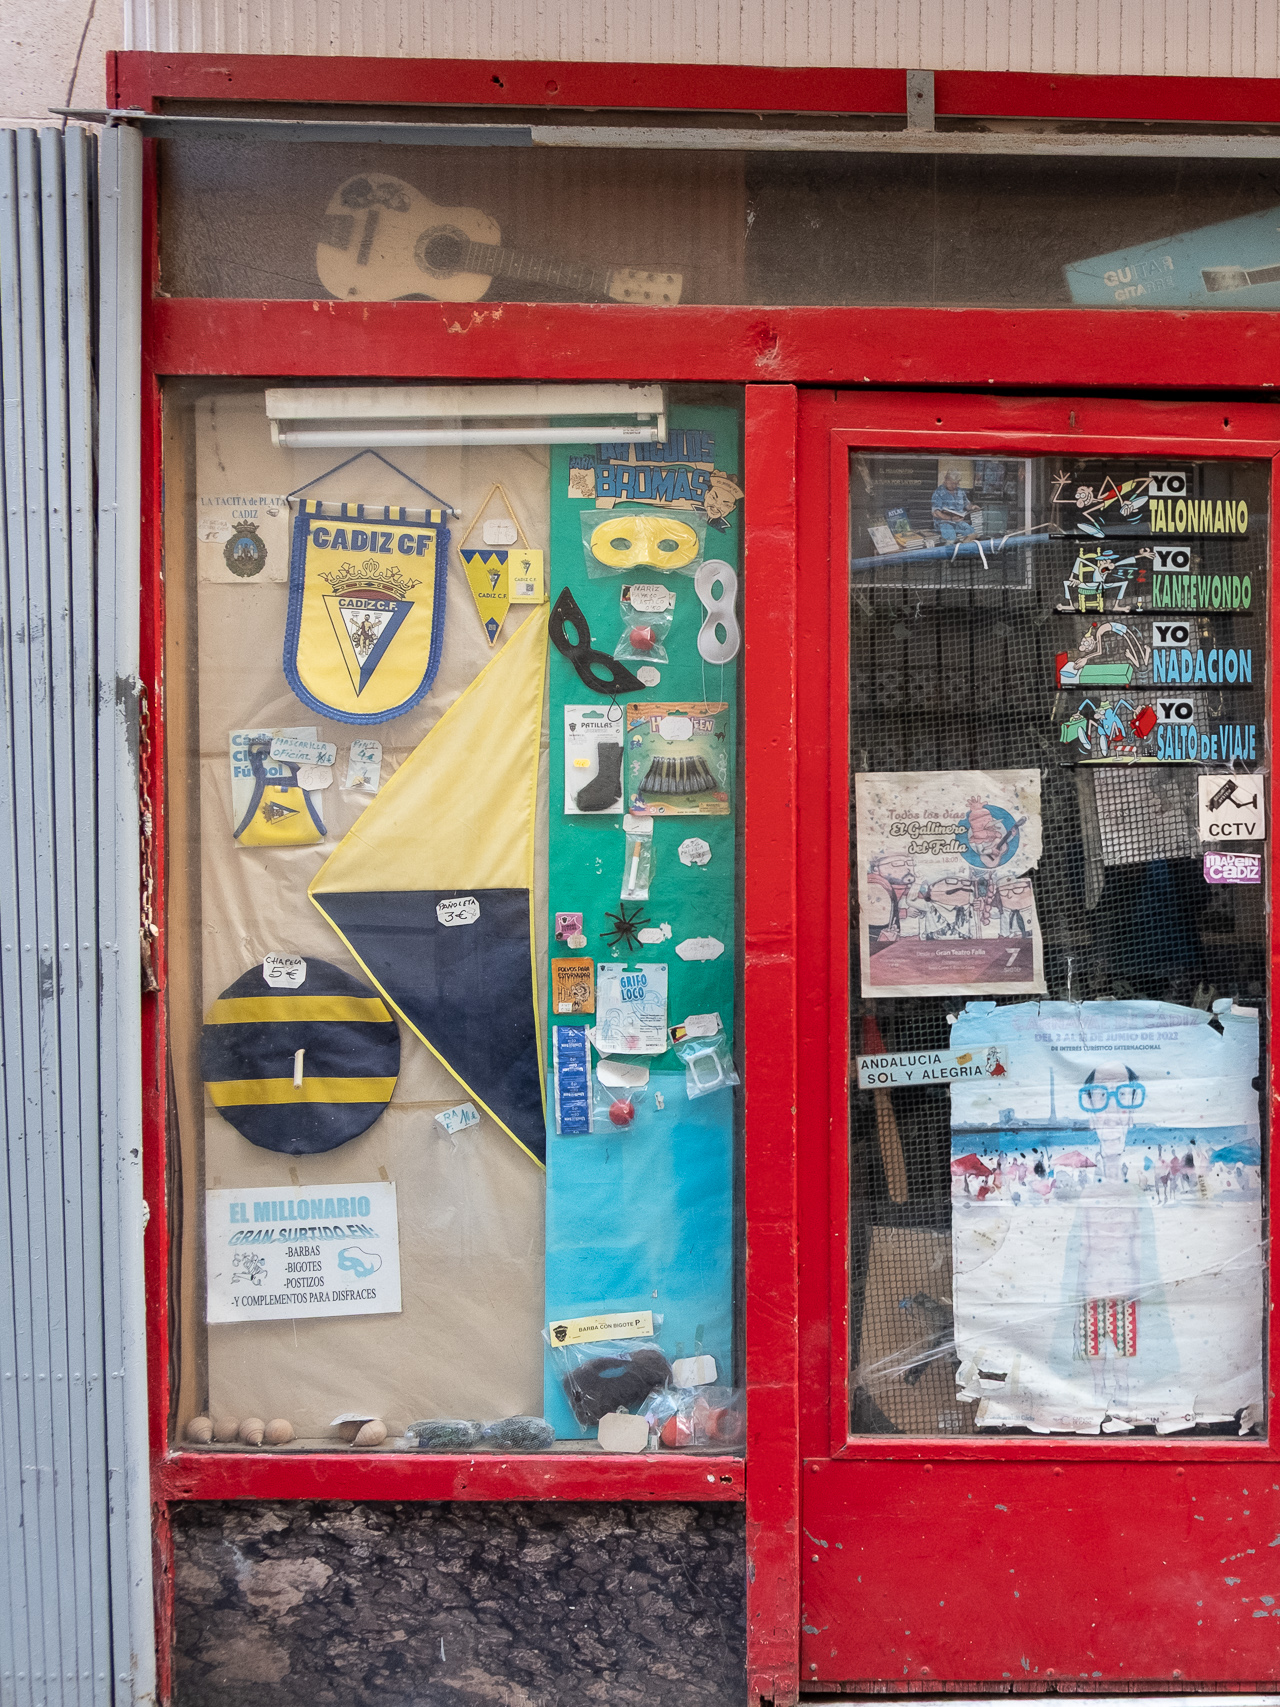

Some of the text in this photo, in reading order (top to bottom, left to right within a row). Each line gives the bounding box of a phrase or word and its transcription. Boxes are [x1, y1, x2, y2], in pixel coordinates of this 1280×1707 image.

[597, 465, 711, 501] BROMAS
[1152, 475, 1185, 493] YO
[201, 497, 287, 506] LA TACITA de PLATA
[232, 510, 259, 519] CADIZ
[1149, 499, 1249, 533] TALONMANO
[312, 526, 433, 557] CADIZ CF
[1156, 550, 1190, 568] YO
[1152, 575, 1251, 609] KANTEWONDO
[338, 599, 376, 610] CADIZ
[1155, 626, 1189, 643] YO
[1153, 649, 1251, 684] NADACION
[1160, 703, 1193, 719] YO
[275, 737, 327, 750] MASCARILLA
[1157, 724, 1256, 760] SALTO DE VIAJE
[888, 808, 965, 820] Todos los días
[889, 821, 968, 839] El Gallinero
[1209, 822, 1256, 836] CCTV
[908, 839, 969, 855] del Falla
[438, 899, 476, 910] PAÑOLETA
[1005, 948, 1021, 966] 7
[620, 973, 647, 988] GRIFO
[621, 987, 645, 1001] LOCO
[1012, 1015, 1111, 1031] CARNAVAL
[1035, 1033, 1053, 1042] DEL
[1063, 1033, 1076, 1042] AL
[1106, 1032, 1138, 1042] JUNIO
[1141, 1032, 1153, 1041] DE
[1156, 1032, 1178, 1040] 2022
[861, 1054, 941, 1070] ANDALUCIA
[868, 1066, 982, 1084] SOL Y ALEGRIA
[229, 1196, 371, 1223] EL MILLONARIO
[228, 1224, 380, 1246] GRAN SURTIDO EN:
[242, 1293, 307, 1306] COMPLEMENTOS
[309, 1291, 330, 1302] PARA
[332, 1288, 377, 1301] DISFRACES
